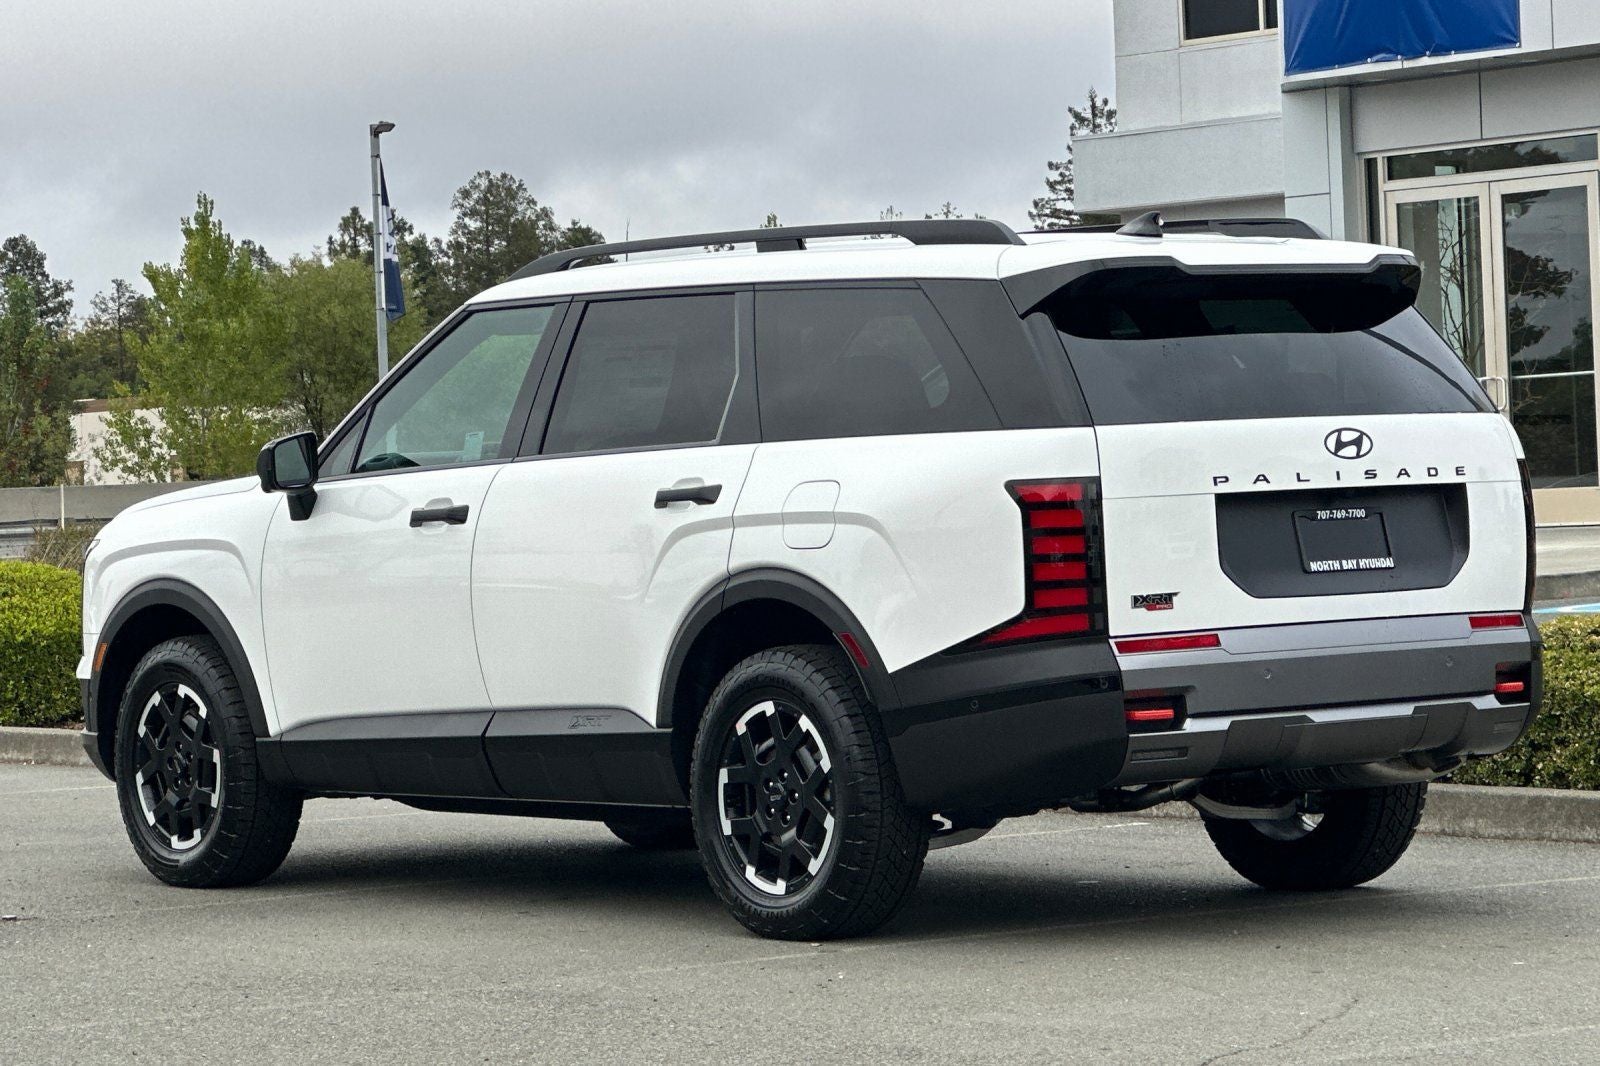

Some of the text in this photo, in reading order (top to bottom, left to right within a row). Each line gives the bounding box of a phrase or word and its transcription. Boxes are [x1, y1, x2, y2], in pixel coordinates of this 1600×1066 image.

[1212, 466, 1467, 487] PALISADE
[1316, 508, 1366, 520] 707-769-7700
[1310, 557, 1394, 572] NORTH BAY HYUNDAI
